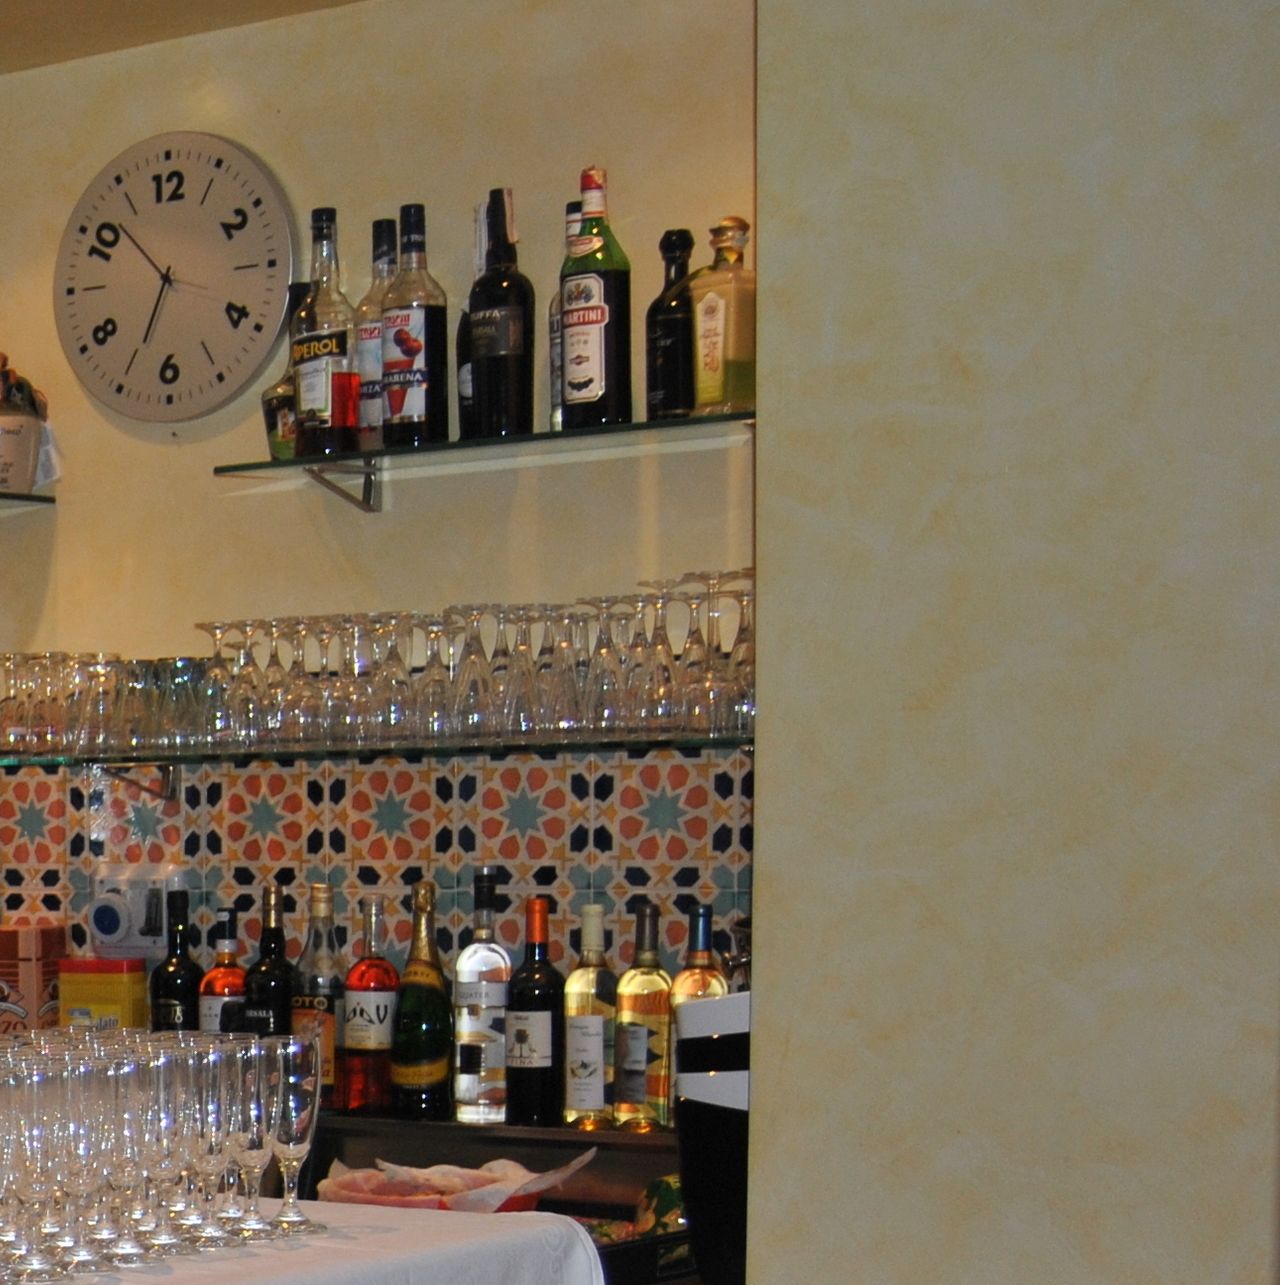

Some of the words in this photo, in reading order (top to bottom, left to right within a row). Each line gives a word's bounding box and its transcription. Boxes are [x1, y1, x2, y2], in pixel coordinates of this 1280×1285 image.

[151, 170, 185, 203] 12
[219, 208, 248, 240] 2
[87, 222, 121, 262] 10
[224, 301, 249, 329] 4
[564, 307, 602, 325] MARTINI
[92, 318, 118, 345] 8
[159, 353, 180, 384] 6
